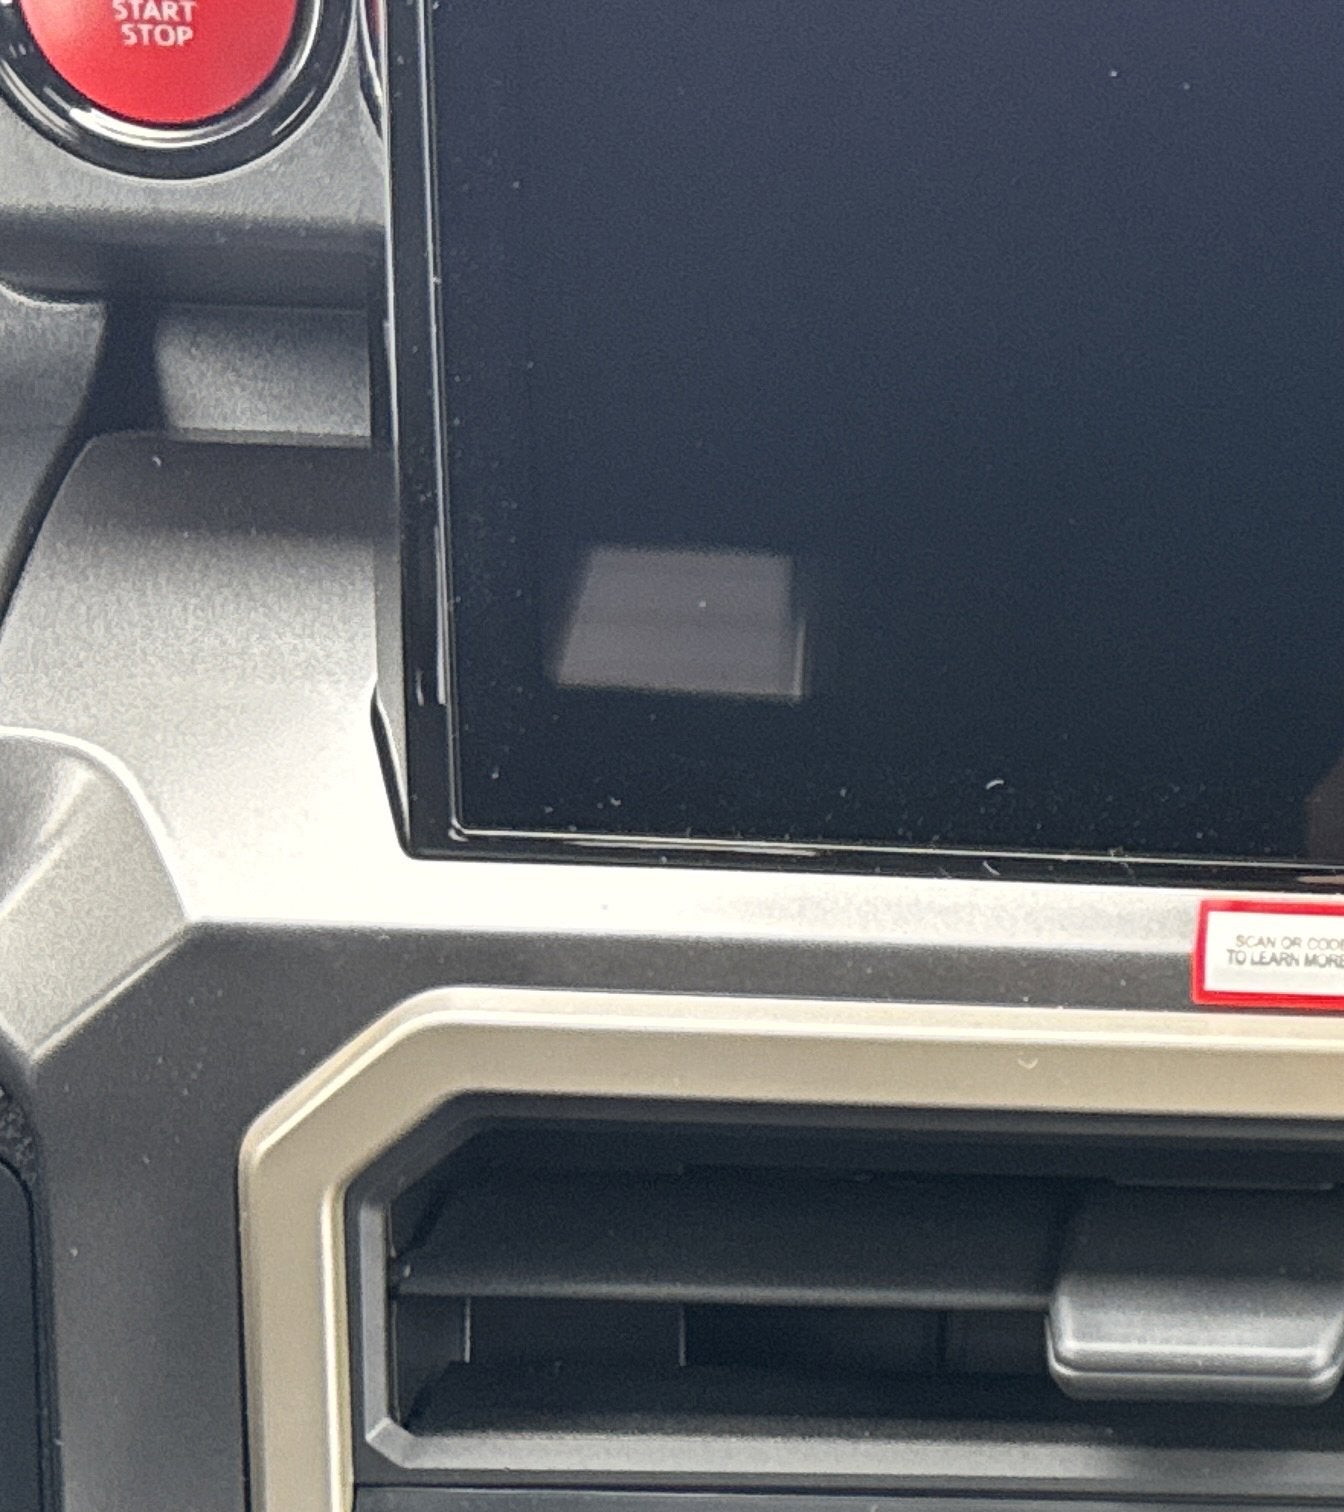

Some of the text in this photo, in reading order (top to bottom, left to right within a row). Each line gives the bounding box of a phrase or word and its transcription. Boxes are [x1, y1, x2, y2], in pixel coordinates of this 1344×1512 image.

[111, 0, 197, 23] START
[120, 22, 195, 47] STOP
[1236, 934, 1276, 948] SCAN
[1226, 949, 1247, 965] TO
[1250, 950, 1300, 967] LEARN
